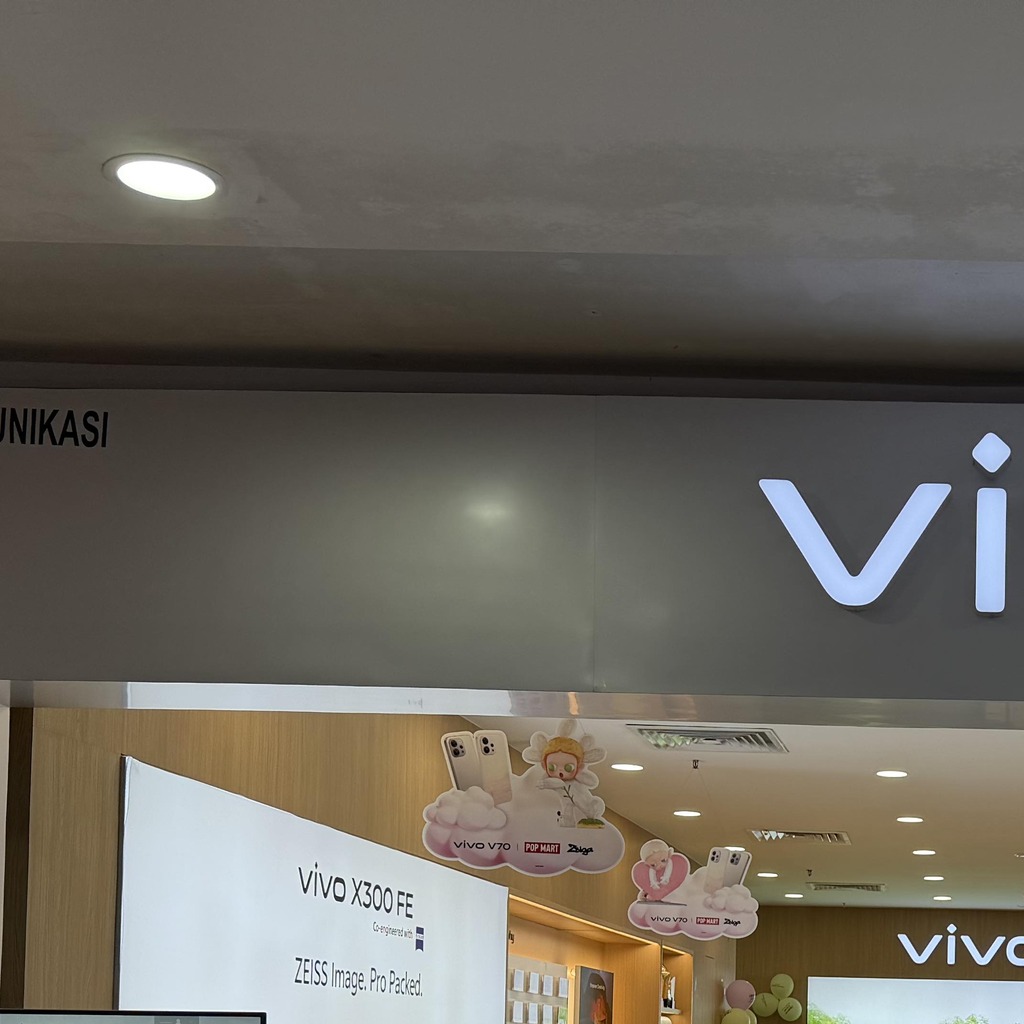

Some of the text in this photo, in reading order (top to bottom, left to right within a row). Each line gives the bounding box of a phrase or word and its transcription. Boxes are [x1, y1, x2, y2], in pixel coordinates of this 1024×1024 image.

[454, 840, 485, 849] vivo
[525, 844, 559, 853] POP MART
[298, 862, 414, 919] vivo X300 FE
[373, 921, 403, 938] Co-engineered
[404, 928, 413, 939] with
[294, 957, 423, 997] ZEISS Image. Pro Packed.
